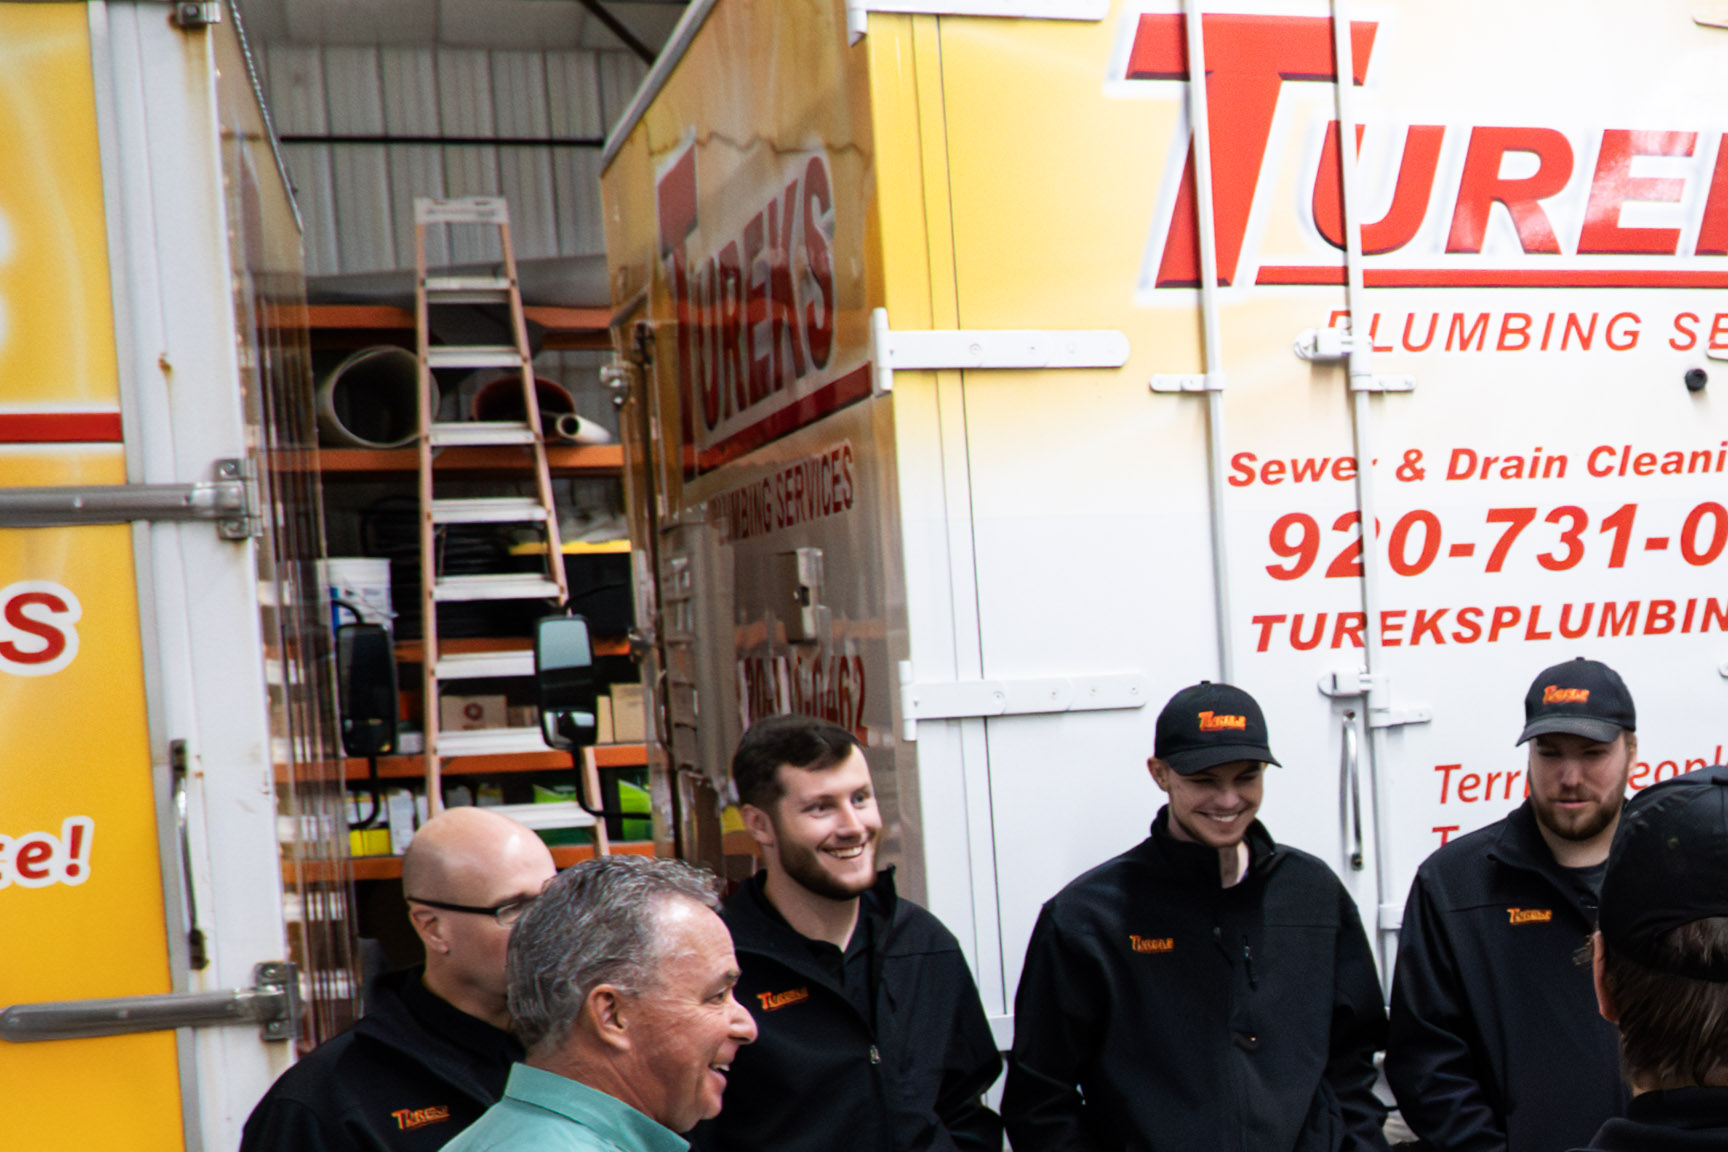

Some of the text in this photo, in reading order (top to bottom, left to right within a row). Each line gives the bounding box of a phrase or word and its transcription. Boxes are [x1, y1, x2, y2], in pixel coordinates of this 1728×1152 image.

[657, 141, 833, 482] TUREKS
[775, 445, 853, 529] SERVICES
[1227, 451, 1378, 488] Sewe
[1395, 448, 1426, 483] &
[1446, 446, 1569, 481] Drain
